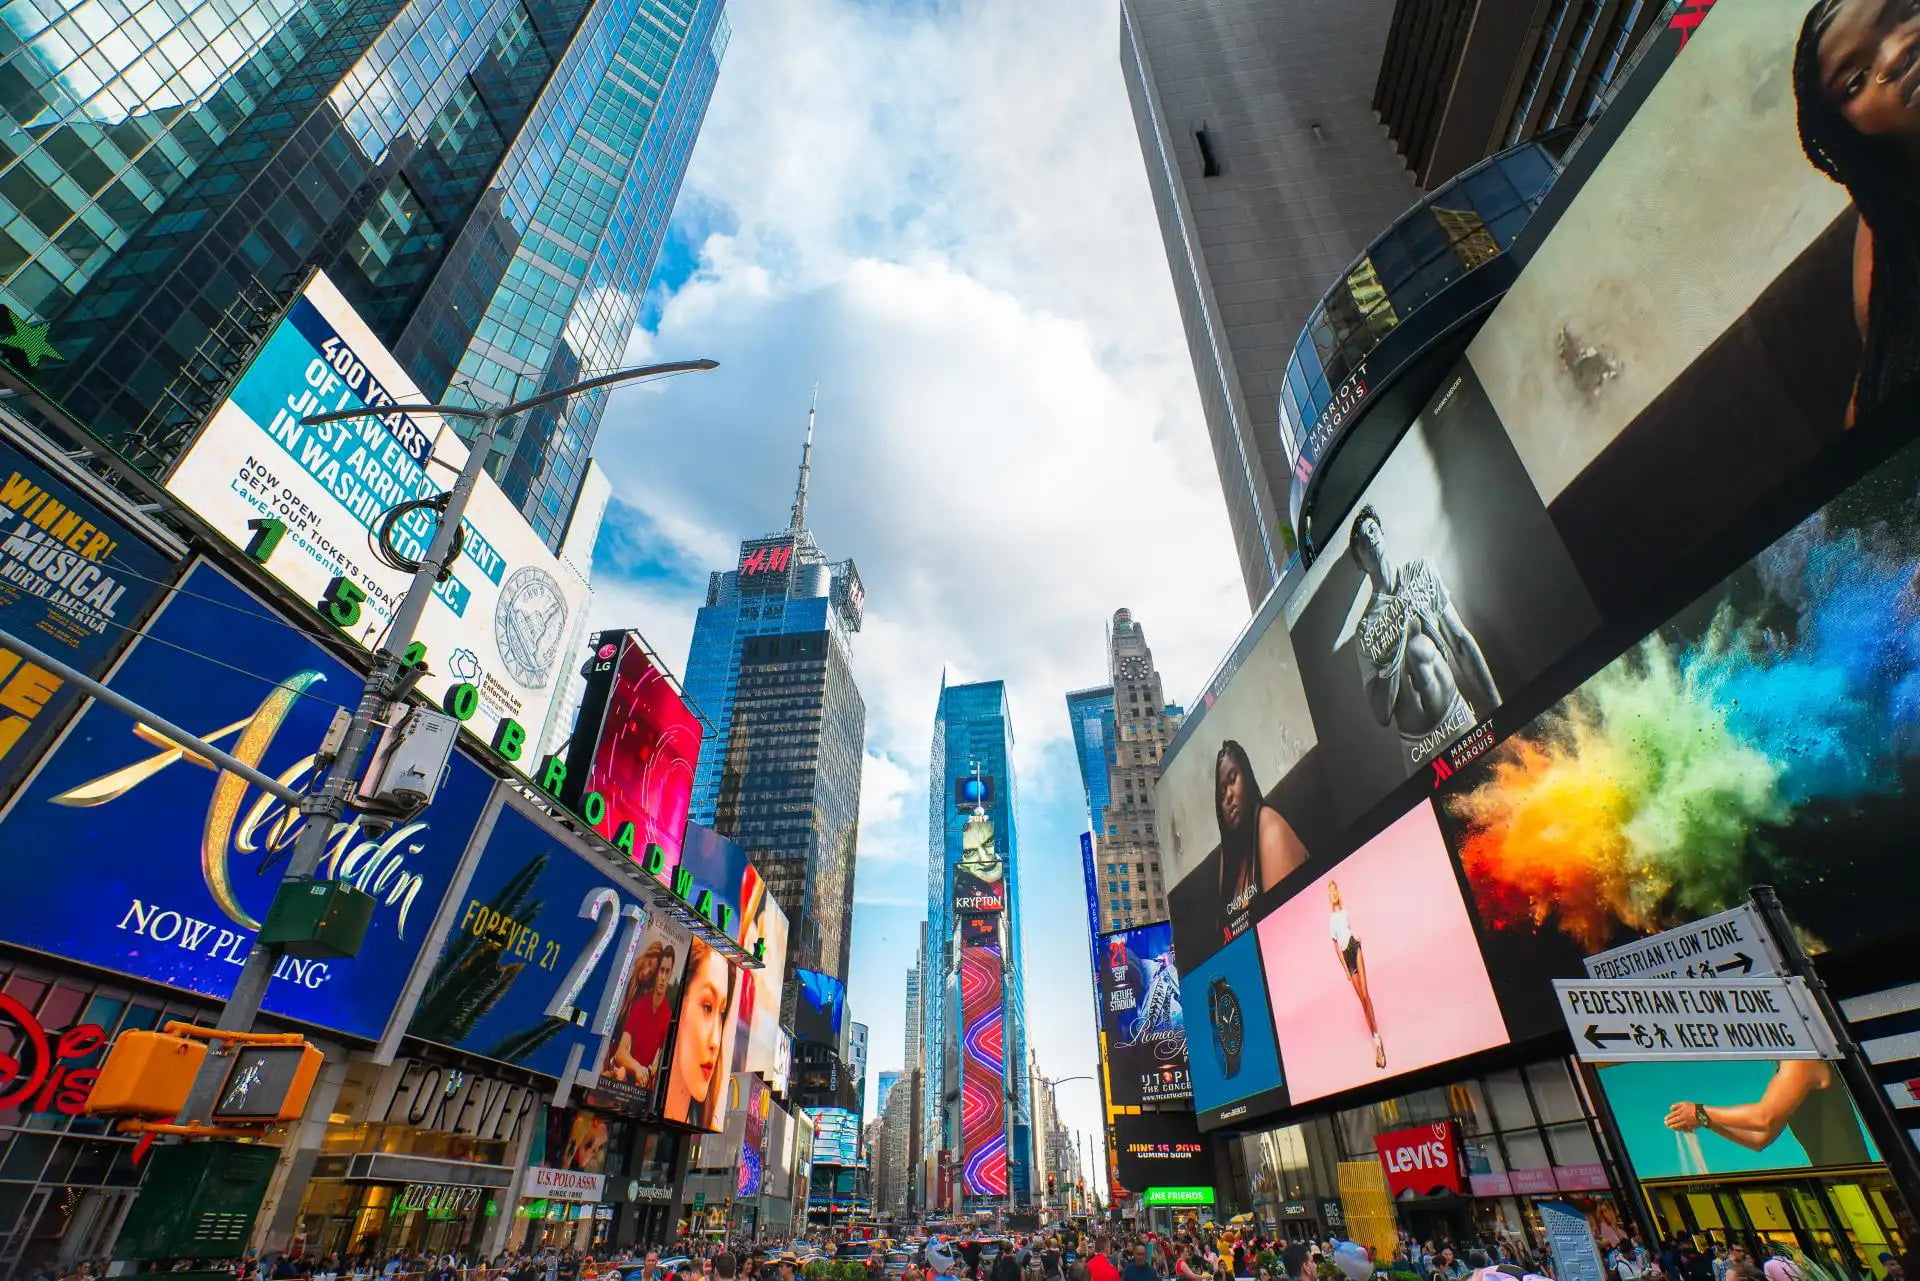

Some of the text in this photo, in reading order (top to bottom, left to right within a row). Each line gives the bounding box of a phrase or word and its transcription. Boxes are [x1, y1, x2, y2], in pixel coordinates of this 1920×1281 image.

[321, 337, 426, 459] 400 YEARS
[1309, 362, 1368, 445] MARRIOTT
[288, 389, 351, 453] JUST
[1314, 386, 1365, 457] MARQUIS
[268, 408, 305, 451] IN
[300, 436, 427, 561] WASHINTO
[305, 358, 342, 396] OF
[381, 443, 502, 577] ENFOMENT
[246, 456, 322, 527] NOW OPEN!
[0, 471, 117, 562] WINNER!
[239, 468, 270, 495] GET
[271, 495, 307, 531] YOUR
[310, 529, 359, 576] TICKETS
[1, 521, 127, 618] MUSICAL
[740, 545, 793, 576] H&M
[1, 560, 52, 598] NORTH
[50, 589, 110, 634] AMERICA
[1365, 609, 1398, 647] SPEAK
[595, 662, 611, 672] LG
[1370, 642, 1381, 661] IN
[480, 688, 505, 714] Museum
[482, 681, 520, 716] Enforcement
[485, 672, 522, 709] National Law
[1411, 701, 1476, 763] CALVIN KLEIN
[1451, 718, 1494, 756] MARRIOTT
[1454, 736, 1494, 768] MARQUIS
[491, 718, 732, 932] BROADWAY
[956, 895, 1002, 908] KRYPTON
[117, 899, 329, 990] NOW PLING
[460, 899, 560, 971] FOREVER 21
[1108, 941, 1128, 967] 21
[1594, 920, 1744, 979] PEDESTRIAN FLOW ZONE
[544, 887, 646, 1036] 21
[1110, 988, 1134, 1001] METLIFE
[1110, 999, 1137, 1012] STADIUM
[1567, 989, 1780, 1015] PEDESTRIAN FLOW ZONE
[1674, 1022, 1796, 1048] KEEP MOVING
[383, 1059, 534, 1142] FOREVER
[1142, 1086, 1159, 1094] THE
[402, 1184, 482, 1211] FOREVER 21
[536, 1171, 551, 1186] U.S.
[553, 1172, 575, 1187] POLO
[1167, 1191, 1203, 1199] FRIENDS
[1324, 1203, 1339, 1216] BIG
